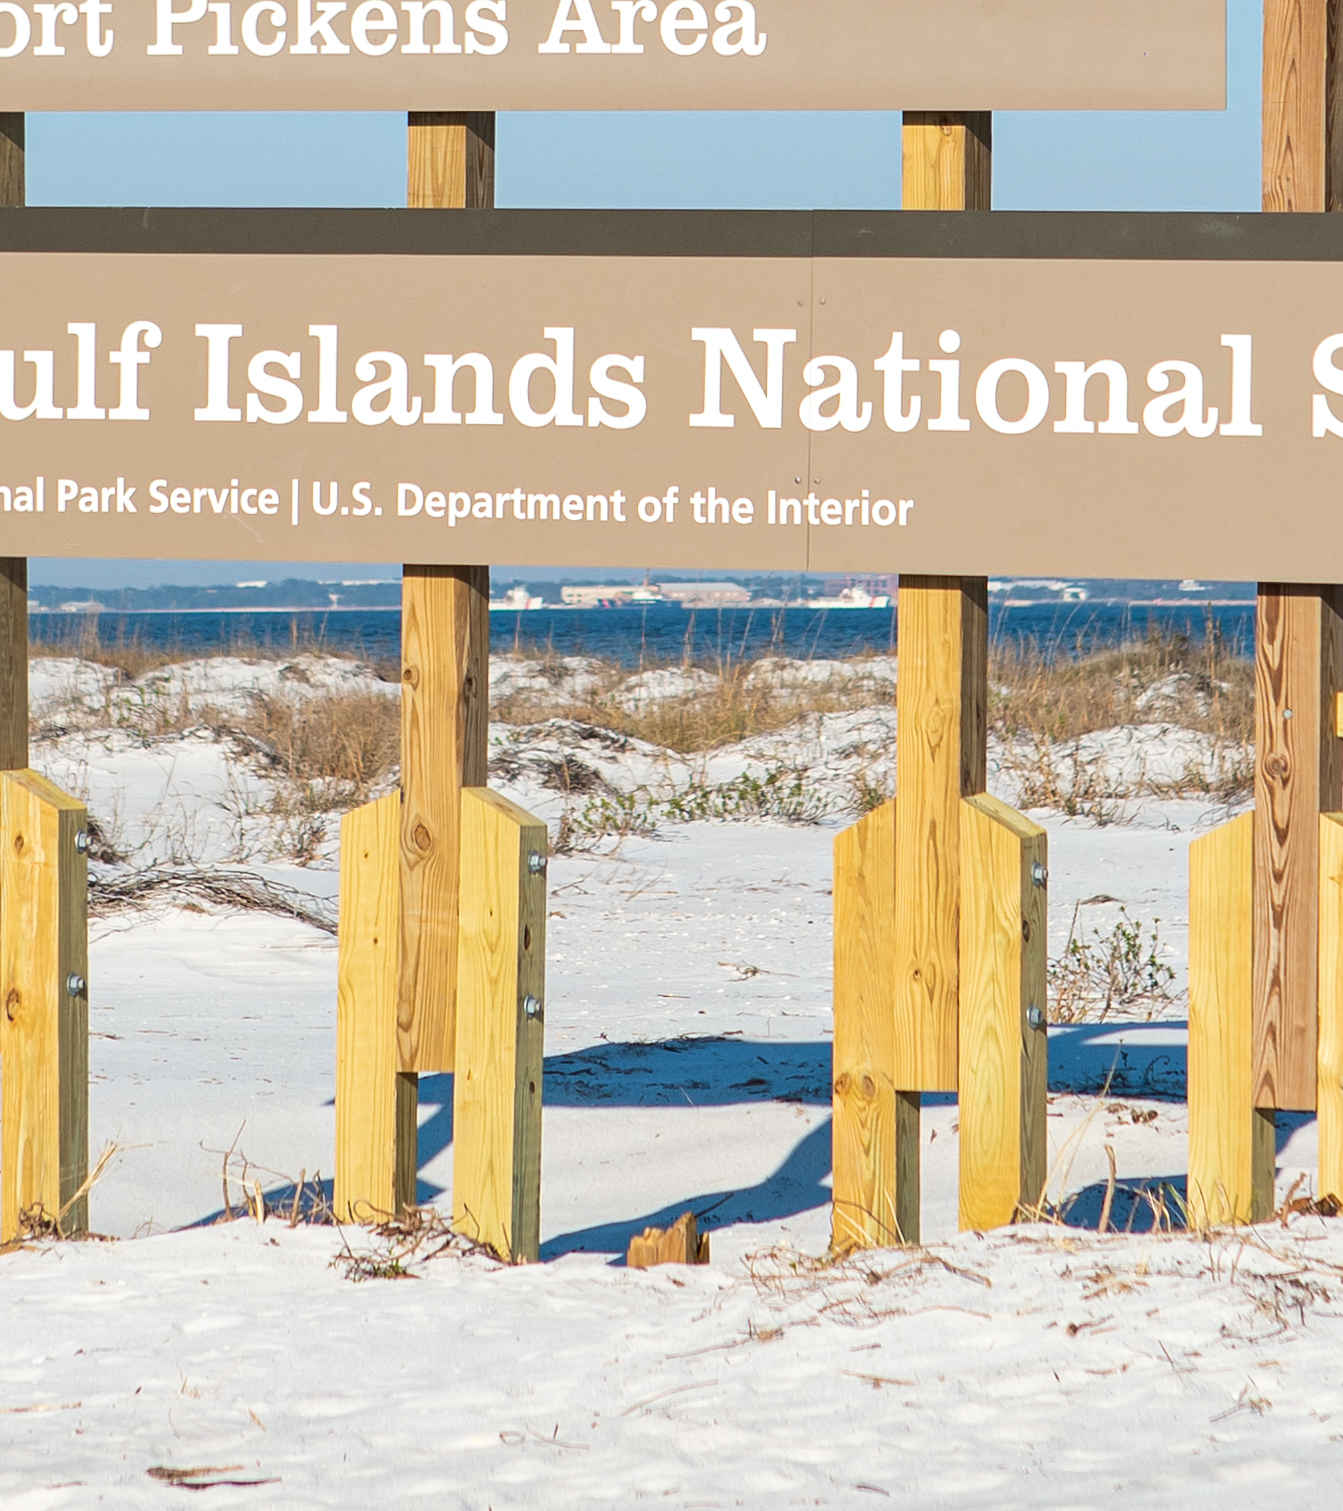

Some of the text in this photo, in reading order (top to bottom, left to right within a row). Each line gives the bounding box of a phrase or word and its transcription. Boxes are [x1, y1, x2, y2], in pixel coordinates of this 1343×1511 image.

[193, 323, 648, 431] Islands
[688, 326, 1264, 438] National
[57, 476, 138, 513] Park
[149, 478, 280, 515] Service
[311, 481, 383, 517] U.S.
[396, 482, 627, 528] Department
[637, 485, 680, 523] of
[689, 486, 755, 525] the
[766, 489, 914, 527] Interior
